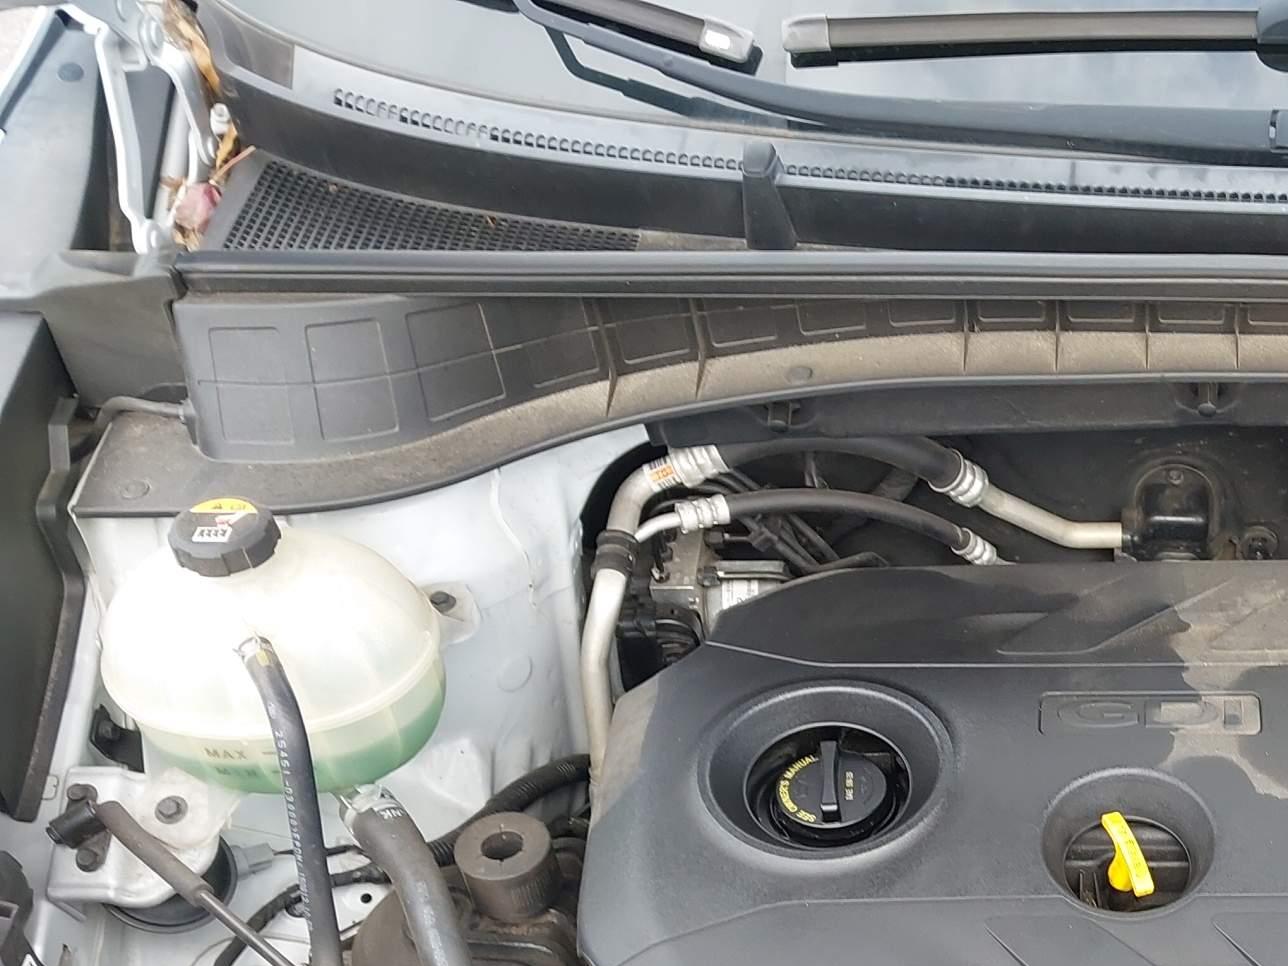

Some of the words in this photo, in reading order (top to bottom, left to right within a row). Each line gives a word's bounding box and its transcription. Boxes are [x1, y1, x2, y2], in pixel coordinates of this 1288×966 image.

[1057, 700, 1243, 729] GDI
[204, 747, 247, 760] MAX
[783, 754, 820, 780] MANUAL
